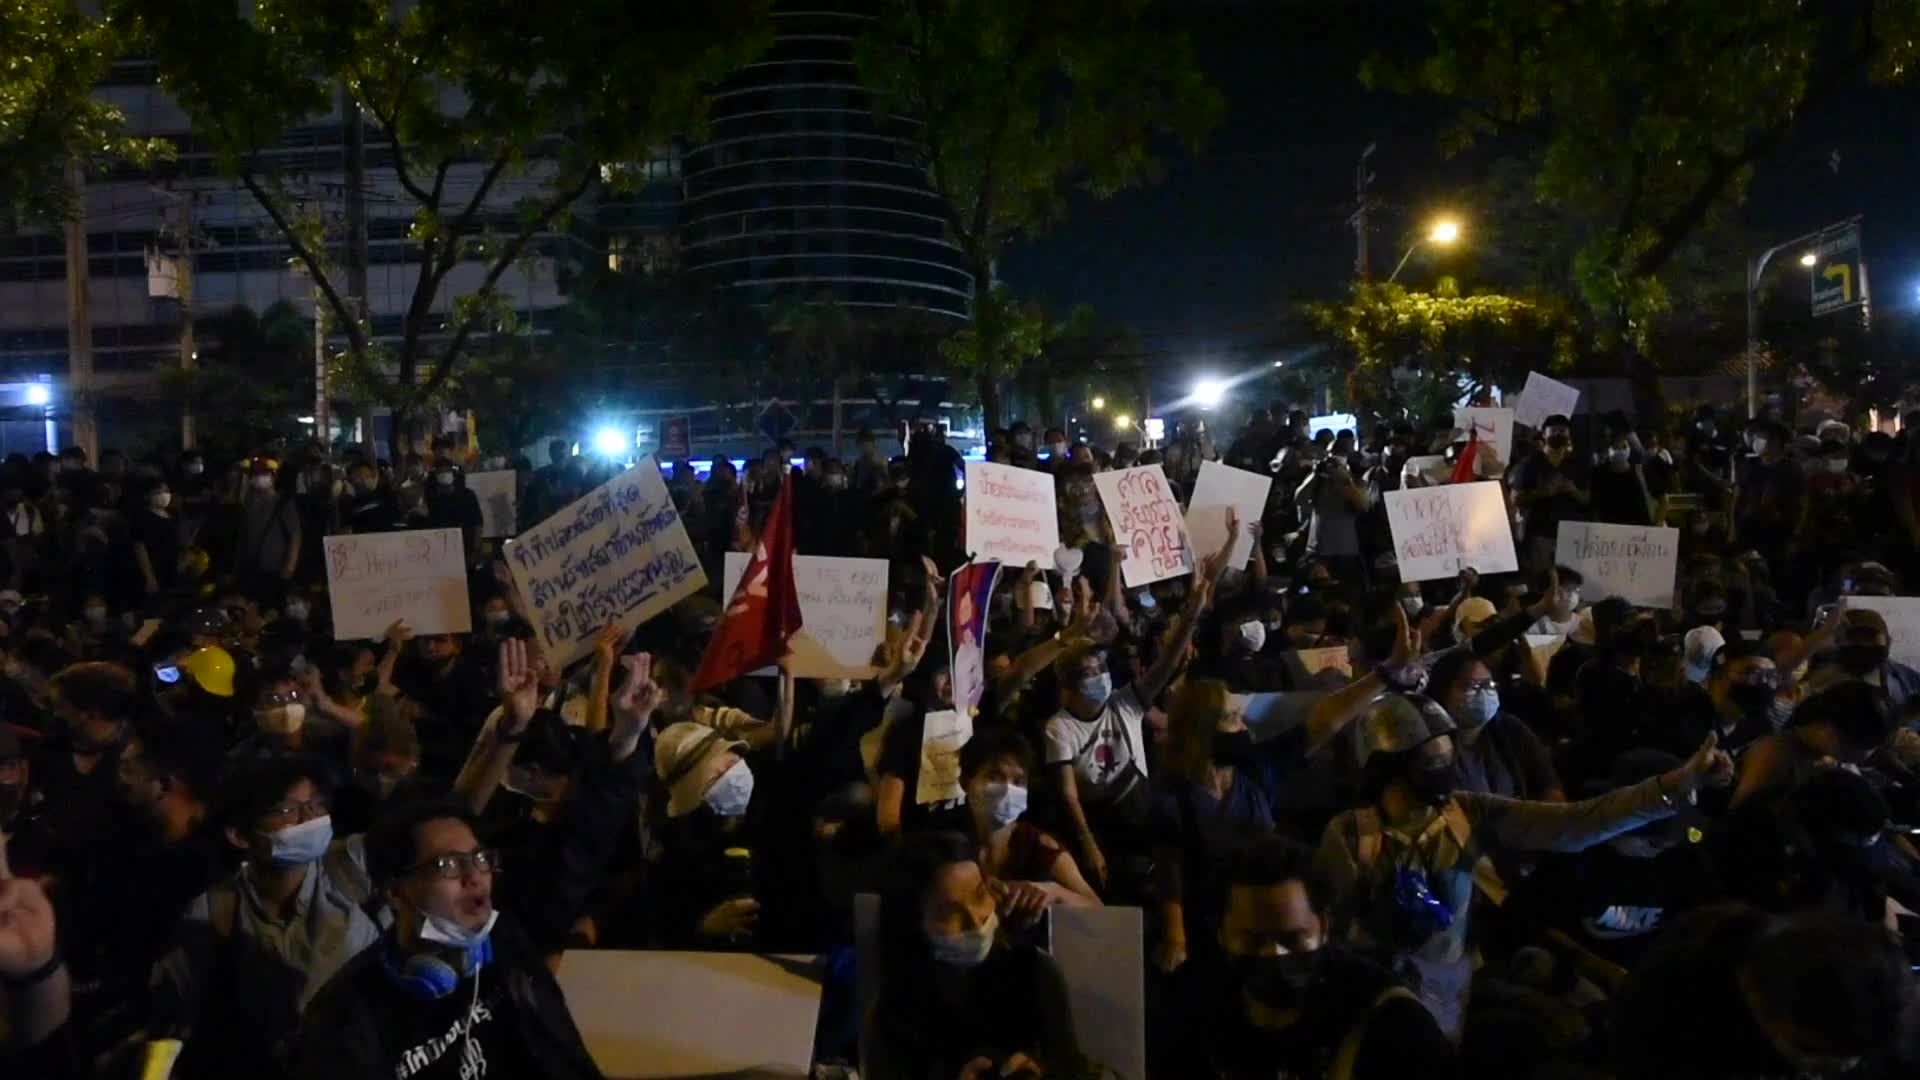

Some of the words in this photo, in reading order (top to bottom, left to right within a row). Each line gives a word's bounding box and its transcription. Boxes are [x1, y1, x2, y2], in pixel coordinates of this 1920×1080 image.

[1118, 471, 1161, 499] ศาล
[1131, 526, 1185, 559] ควย
[1597, 905, 1664, 930] NIKE
